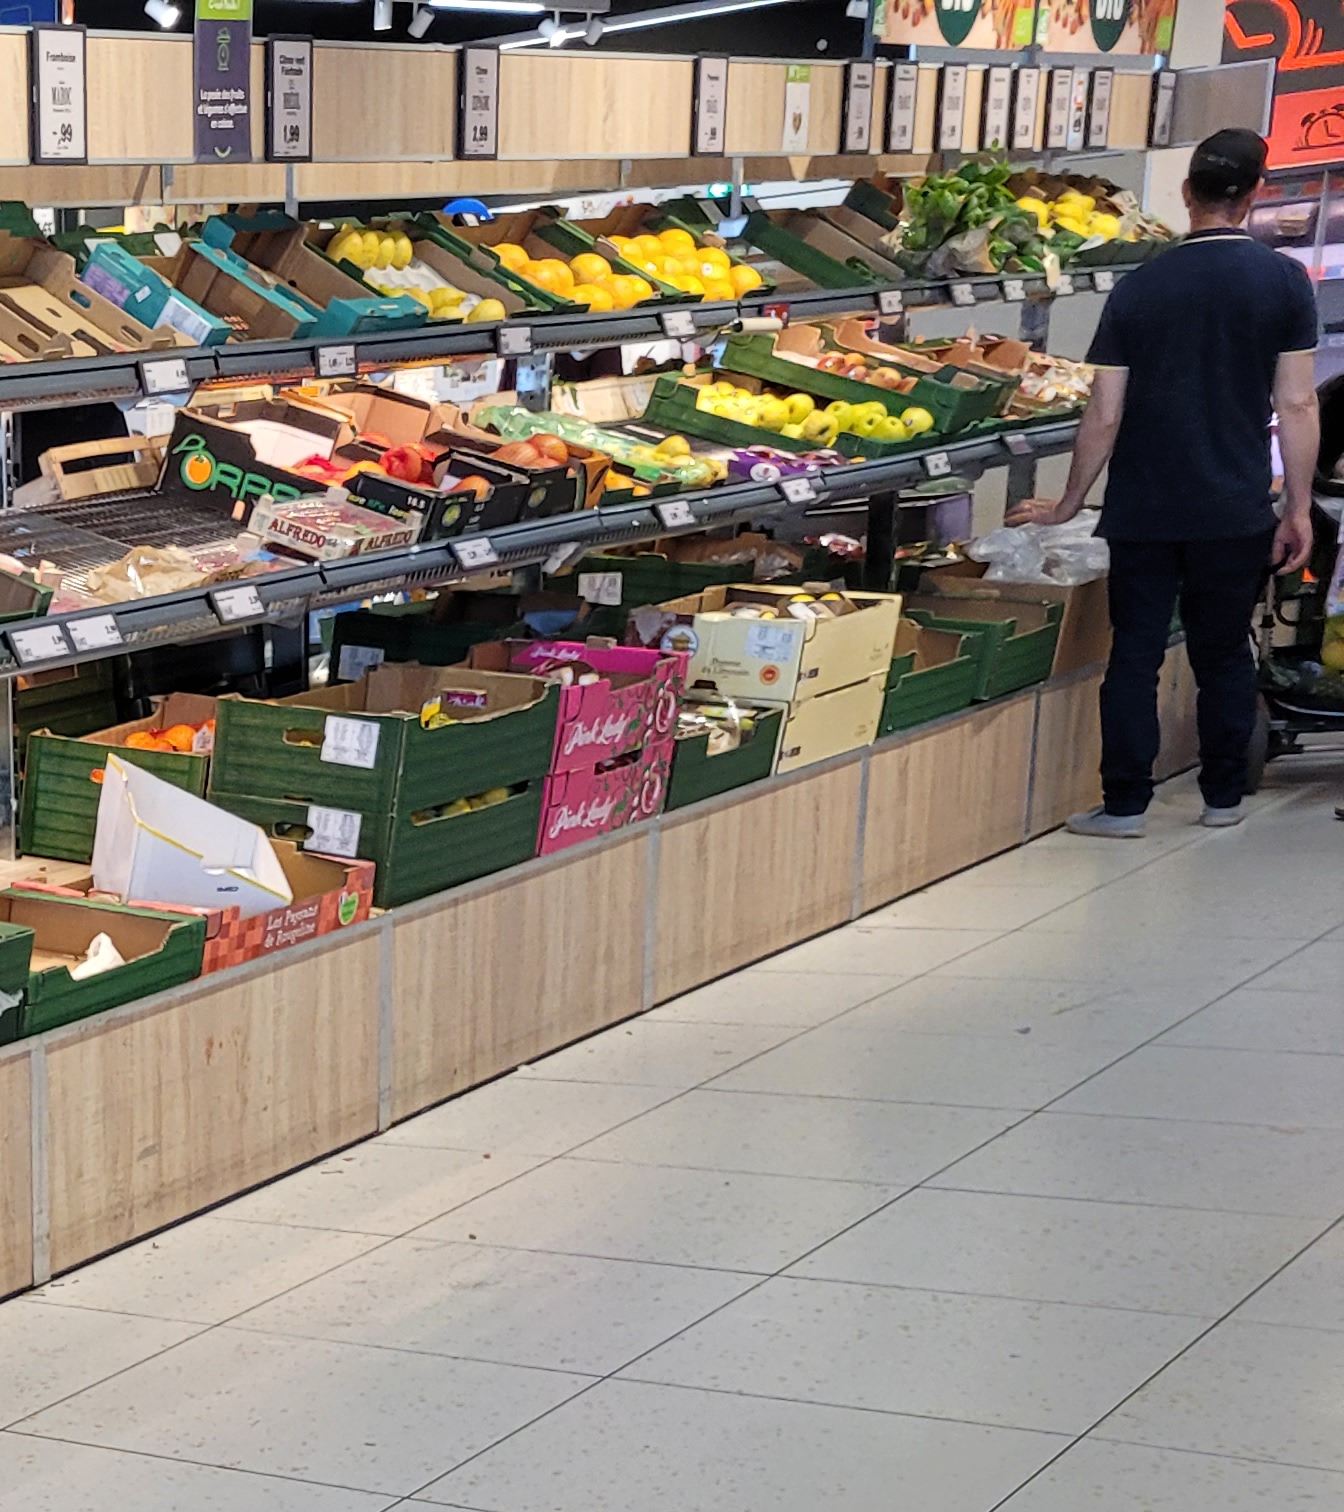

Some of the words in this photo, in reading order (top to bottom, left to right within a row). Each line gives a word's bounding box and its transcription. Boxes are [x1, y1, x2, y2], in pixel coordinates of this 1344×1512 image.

[46, 51, 76, 63] Framboise
[267, 518, 327, 548] ALFREDO
[366, 529, 413, 552] ALFREDO
